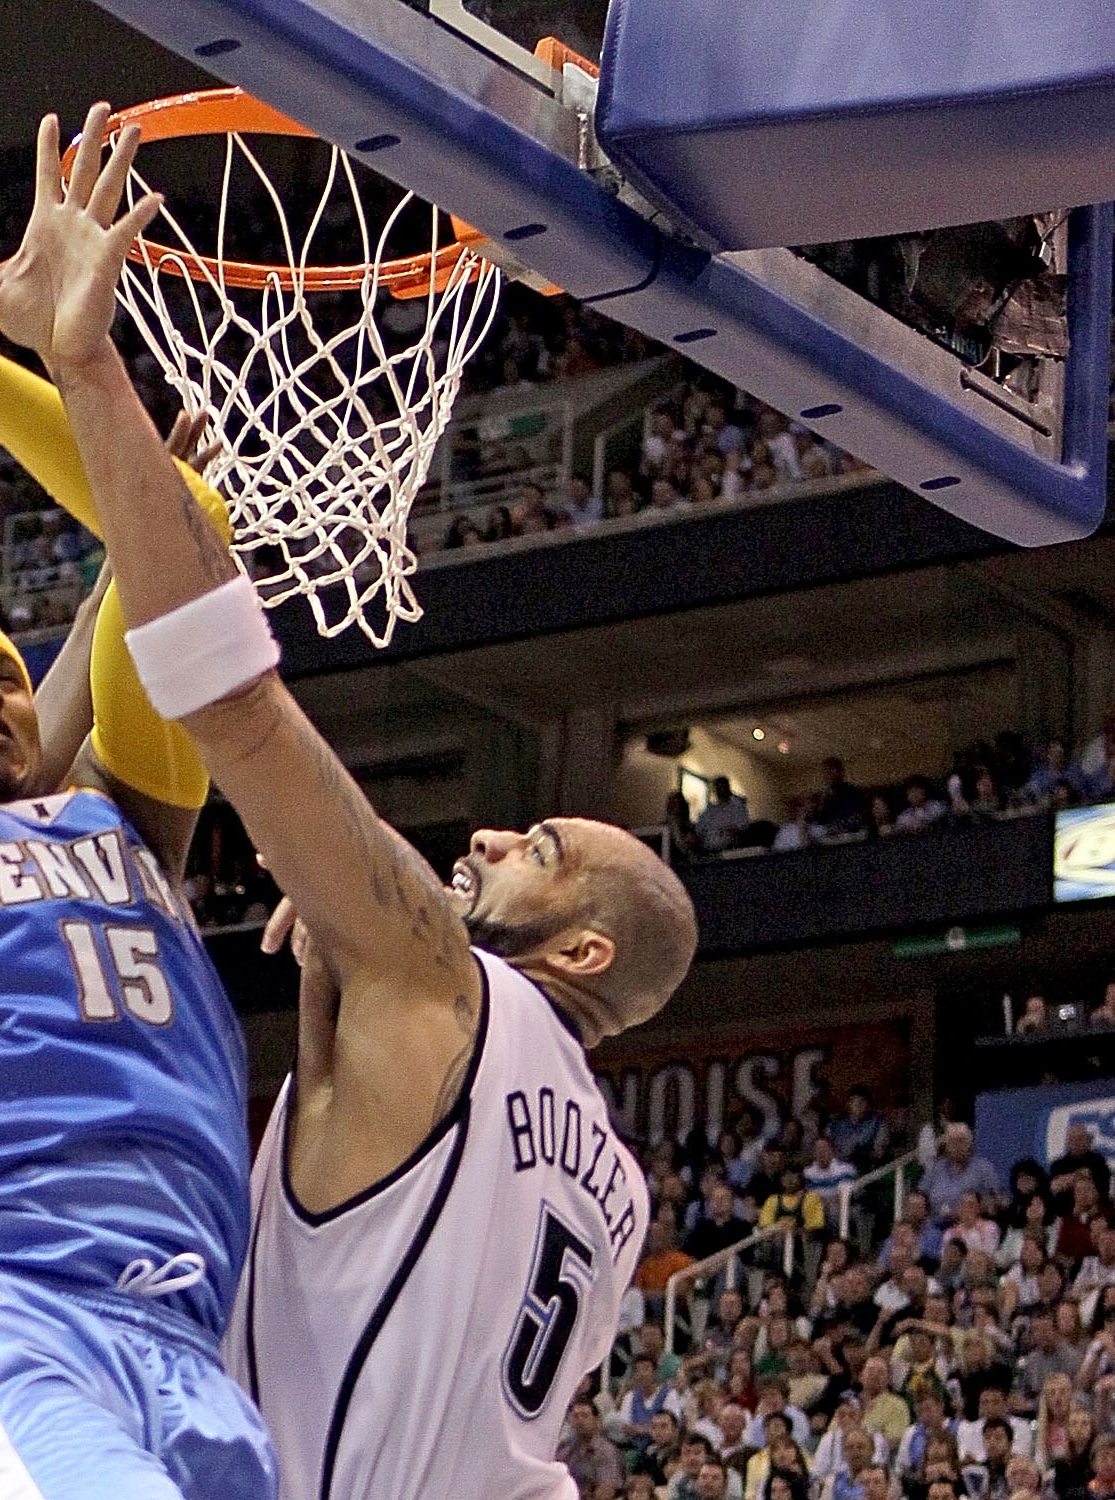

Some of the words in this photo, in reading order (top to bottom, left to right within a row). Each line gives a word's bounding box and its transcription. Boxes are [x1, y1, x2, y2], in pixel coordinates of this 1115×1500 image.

[59, 918, 175, 1027] 15
[506, 1087, 637, 1265] BOOZER
[500, 1198, 598, 1421] 5
